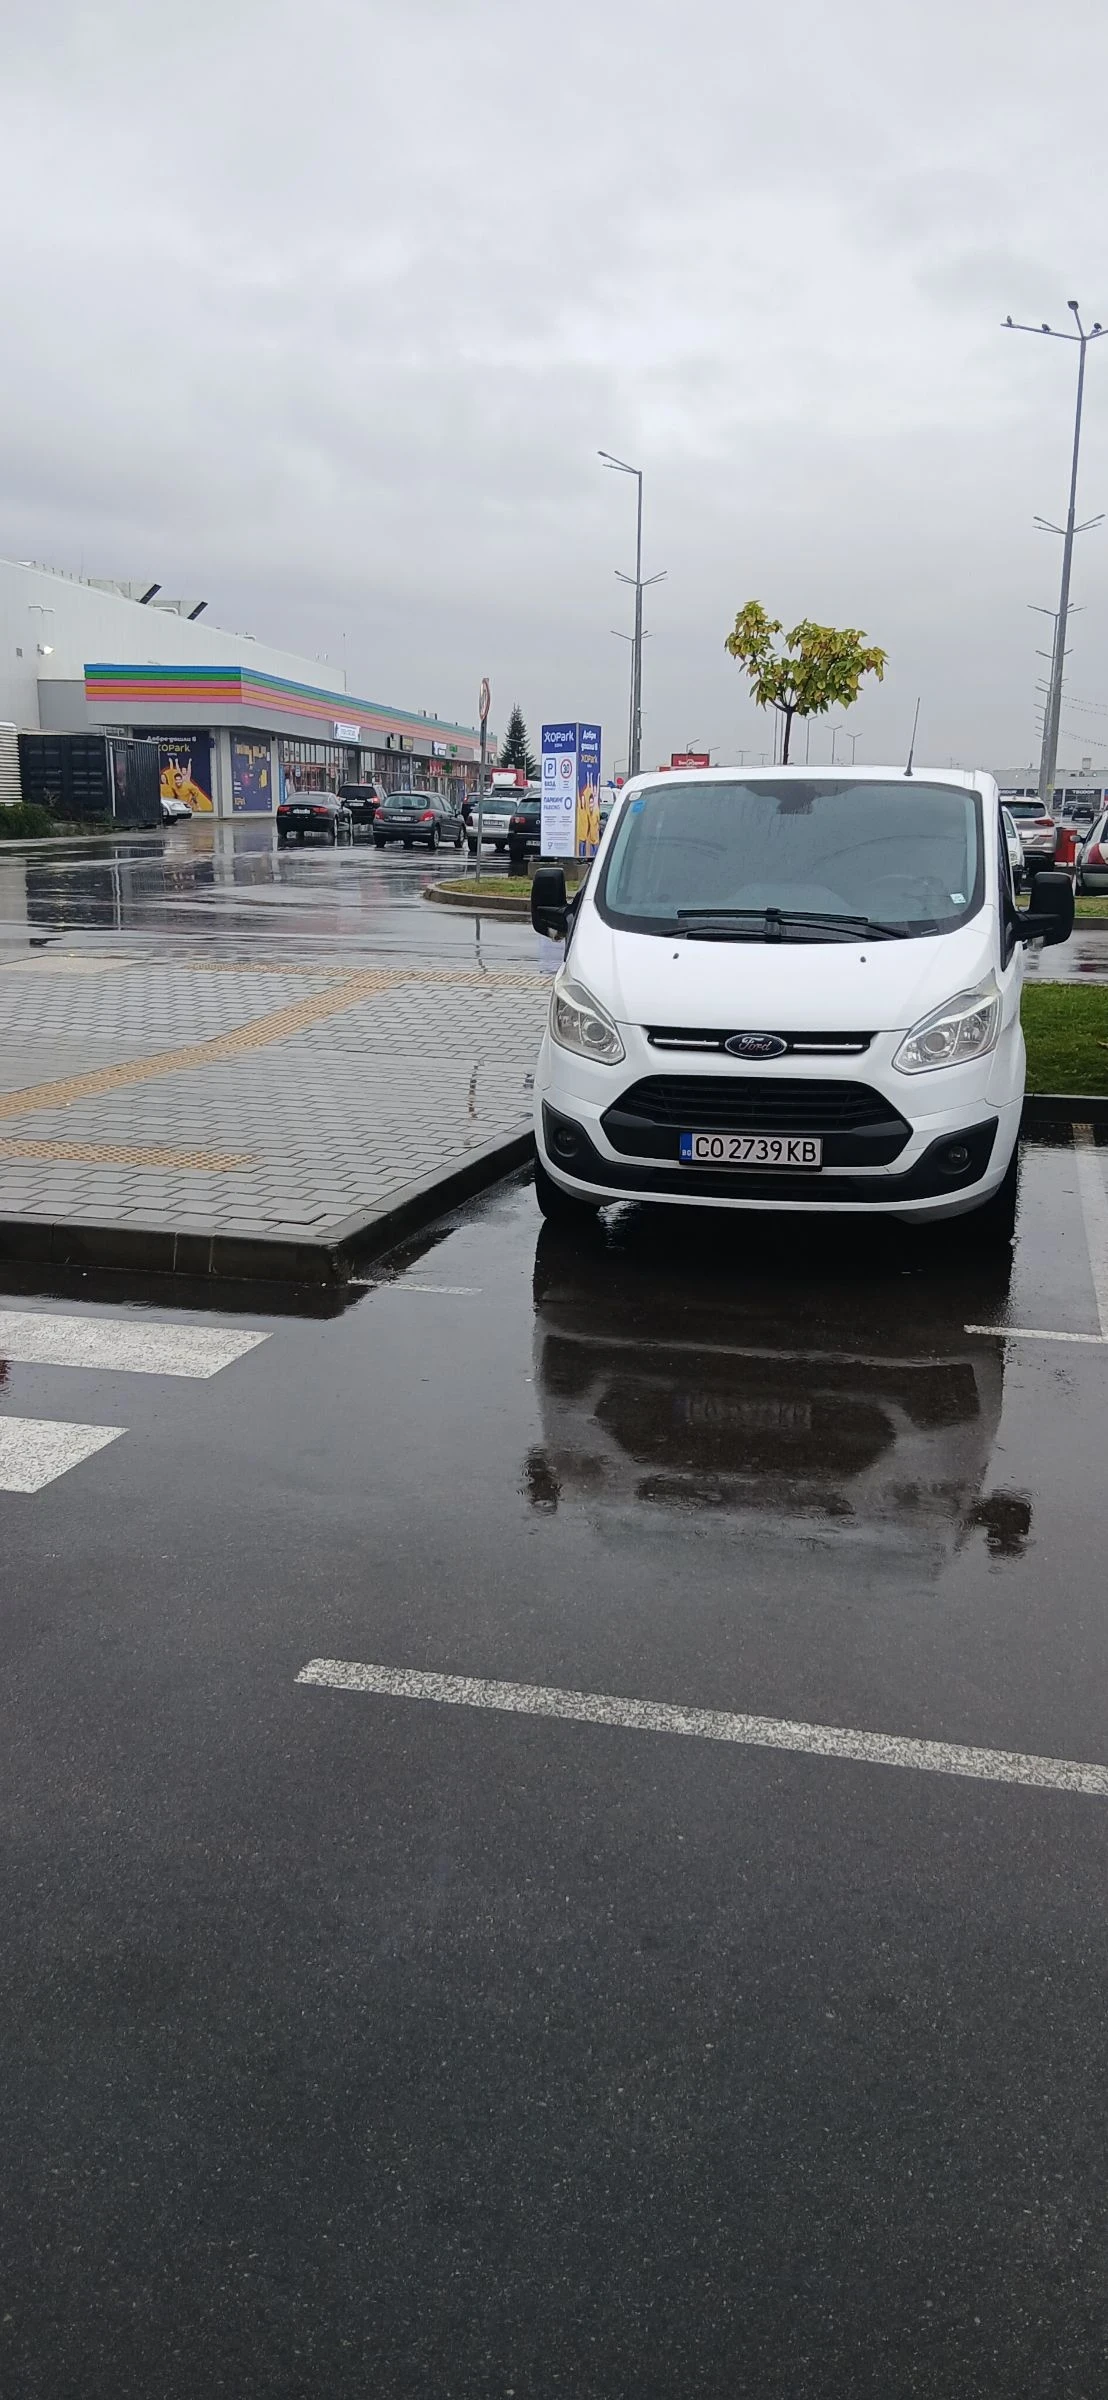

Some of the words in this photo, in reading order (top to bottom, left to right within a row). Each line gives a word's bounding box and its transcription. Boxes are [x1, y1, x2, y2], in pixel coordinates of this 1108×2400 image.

[738, 1036, 772, 1051] Ford
[728, 1138, 783, 1161] 2739
[787, 1140, 817, 1163] KB
